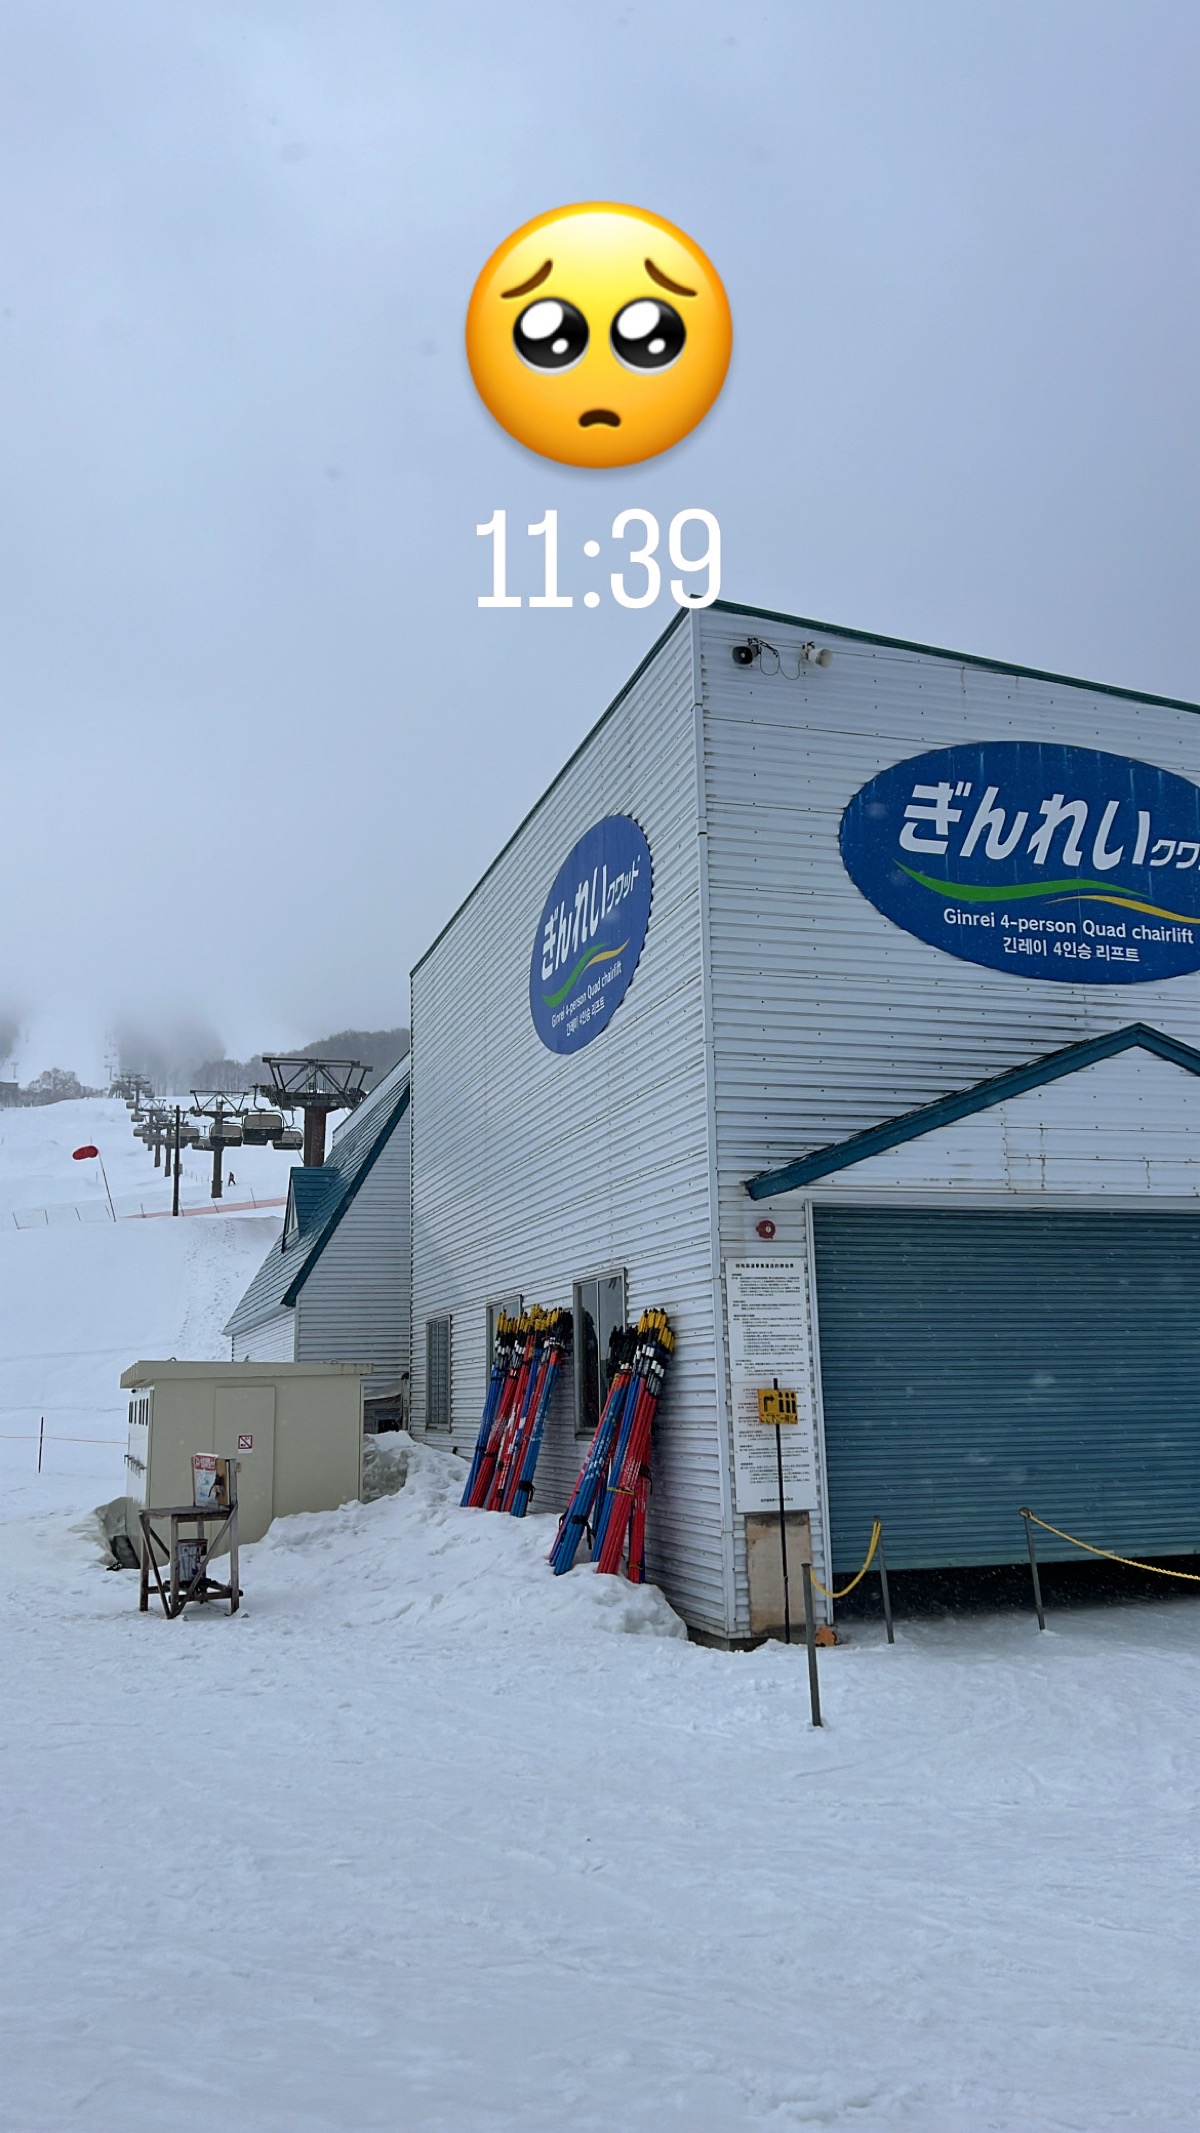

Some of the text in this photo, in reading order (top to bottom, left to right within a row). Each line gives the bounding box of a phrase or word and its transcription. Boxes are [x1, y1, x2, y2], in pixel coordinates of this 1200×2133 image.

[899, 781, 1200, 871] ぎんれいクワ
[541, 855, 641, 981] ぎんれいクワッド
[943, 908, 1194, 944] Ginrei 4-person Quad chairlift
[1003, 936, 1140, 962] 긴레이 4인승 리프트
[551, 1006, 565, 1028] Ginrei
[587, 977, 601, 999] Quad
[601, 960, 622, 988] chairlift
